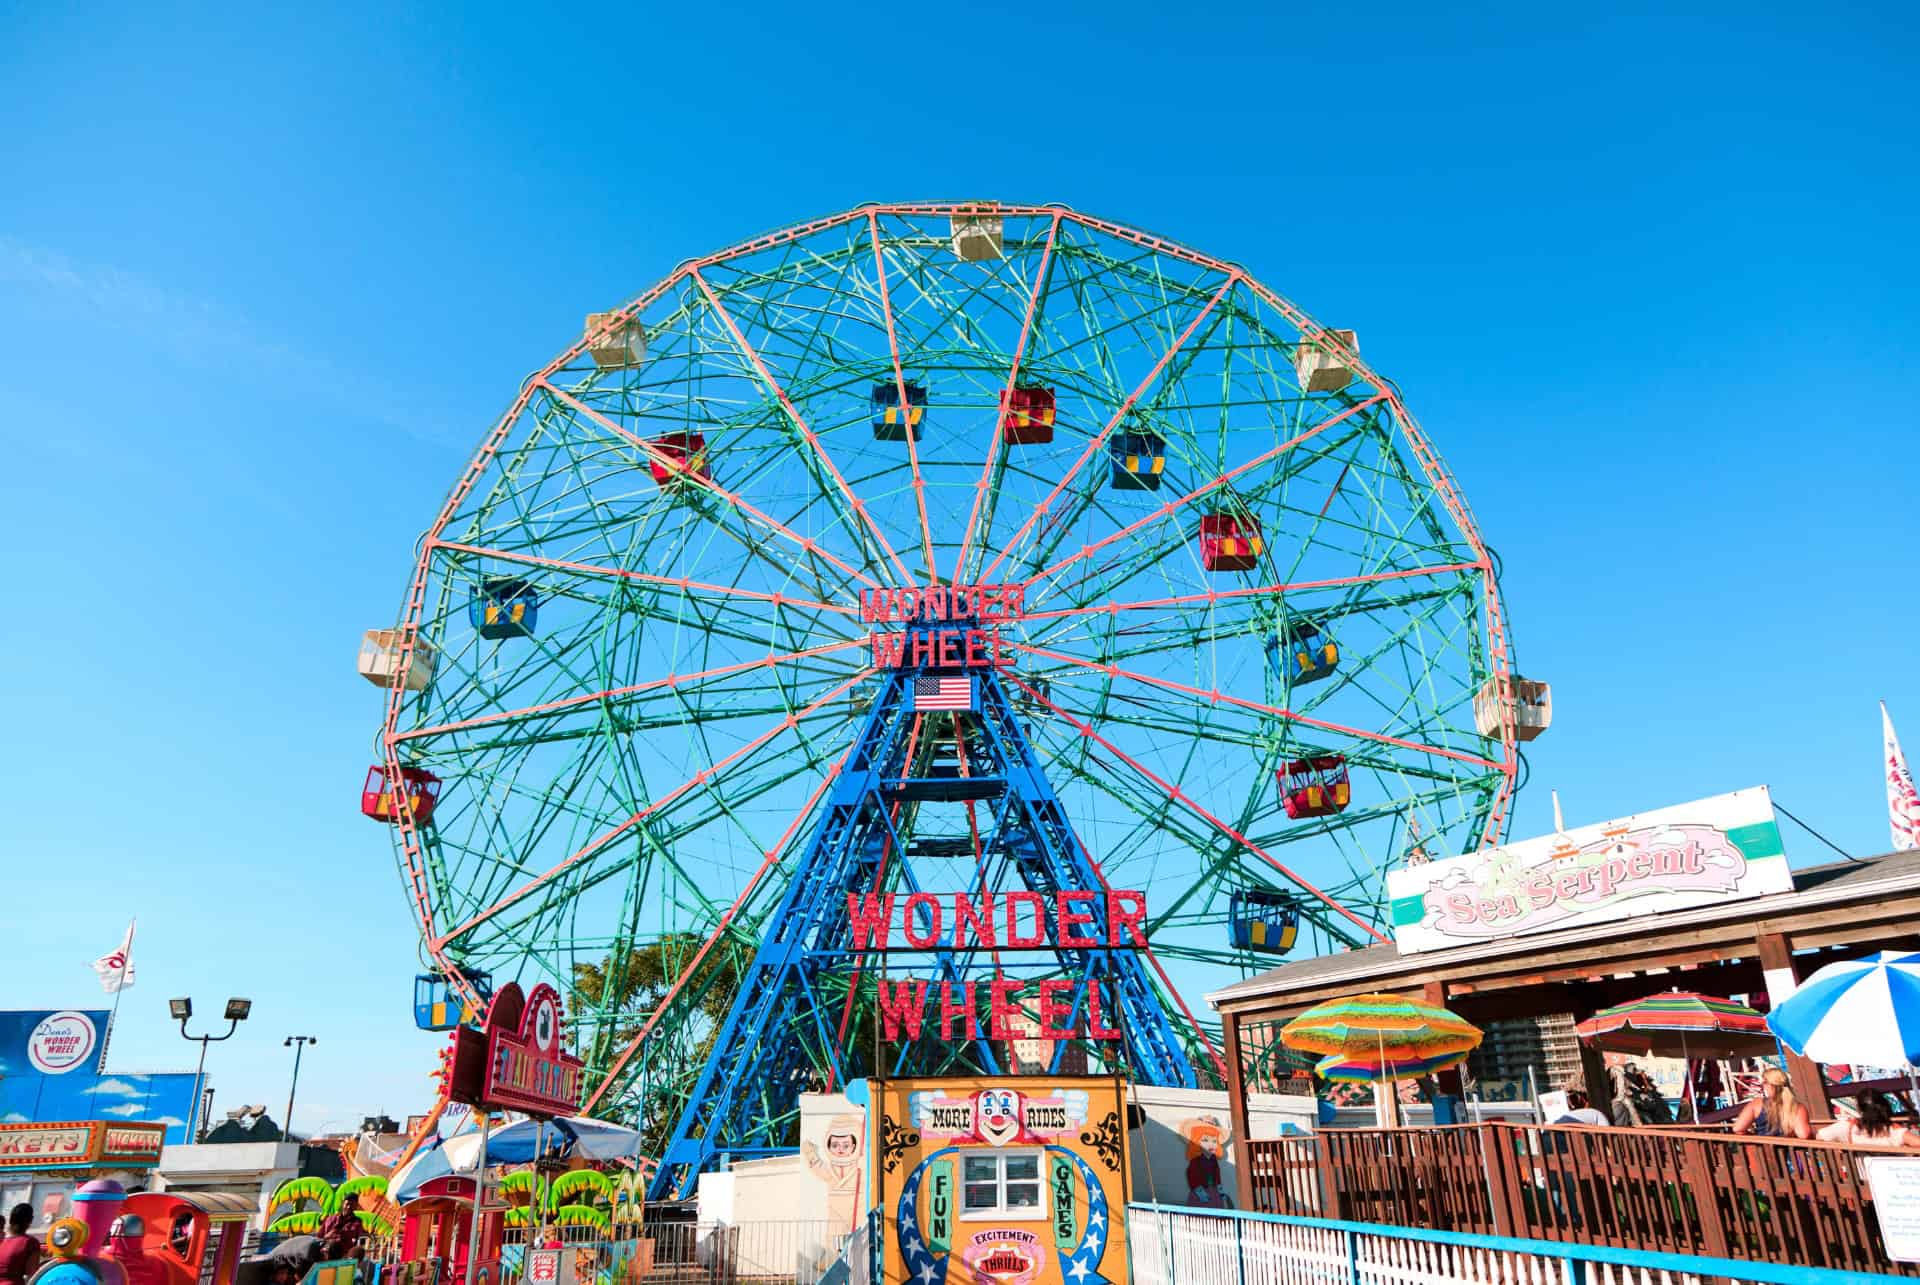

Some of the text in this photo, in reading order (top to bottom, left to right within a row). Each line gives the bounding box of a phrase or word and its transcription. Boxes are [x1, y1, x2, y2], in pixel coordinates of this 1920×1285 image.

[860, 585, 1024, 623] WONDER
[871, 629, 1017, 668] WHEEL
[1446, 839, 1705, 924] Sea Serpent
[847, 889, 1148, 950] WONDER
[877, 979, 1121, 1041] WHEEL
[44, 1036, 80, 1045] WONDER
[932, 1108, 1065, 1128] MORE RIDES
[0, 1133, 80, 1153] KETS
[108, 1132, 160, 1150] TICKETS
[935, 1175, 947, 1239] FUN
[1055, 1165, 1072, 1238] GAMES
[974, 1230, 1036, 1245] EXCITEMENT
[981, 1257, 1028, 1273] THRILLS
